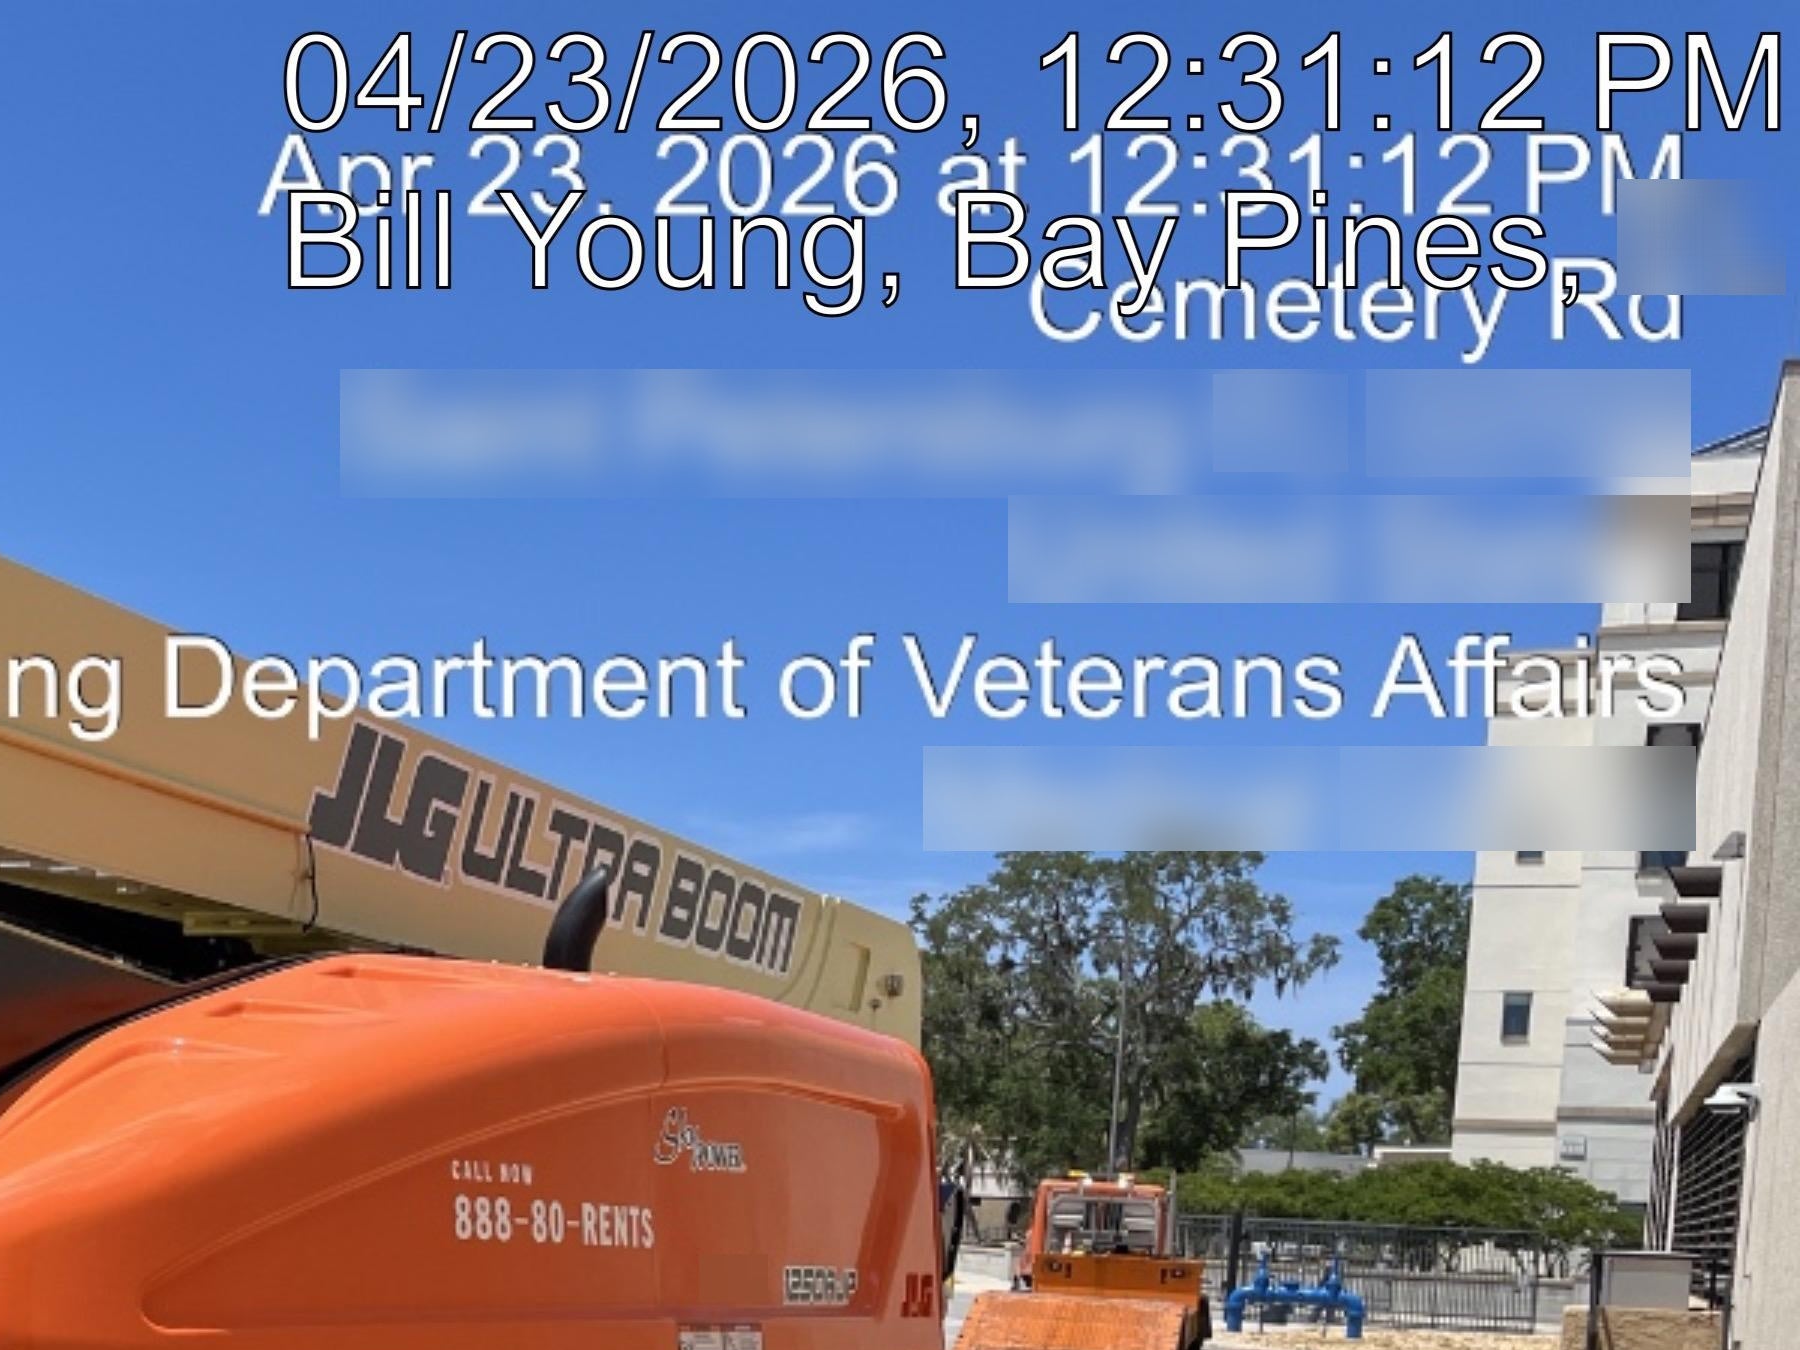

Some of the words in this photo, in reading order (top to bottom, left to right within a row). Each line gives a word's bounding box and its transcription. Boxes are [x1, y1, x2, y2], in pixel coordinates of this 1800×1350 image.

[308, 718, 471, 889] JLG
[458, 773, 663, 930] ULTRA
[658, 852, 804, 976] BOOM
[451, 1159, 493, 1184] CALL
[499, 1162, 534, 1187] NOW
[455, 1192, 656, 1249] 888-80-RENTS
[901, 1272, 934, 1318] JLG
